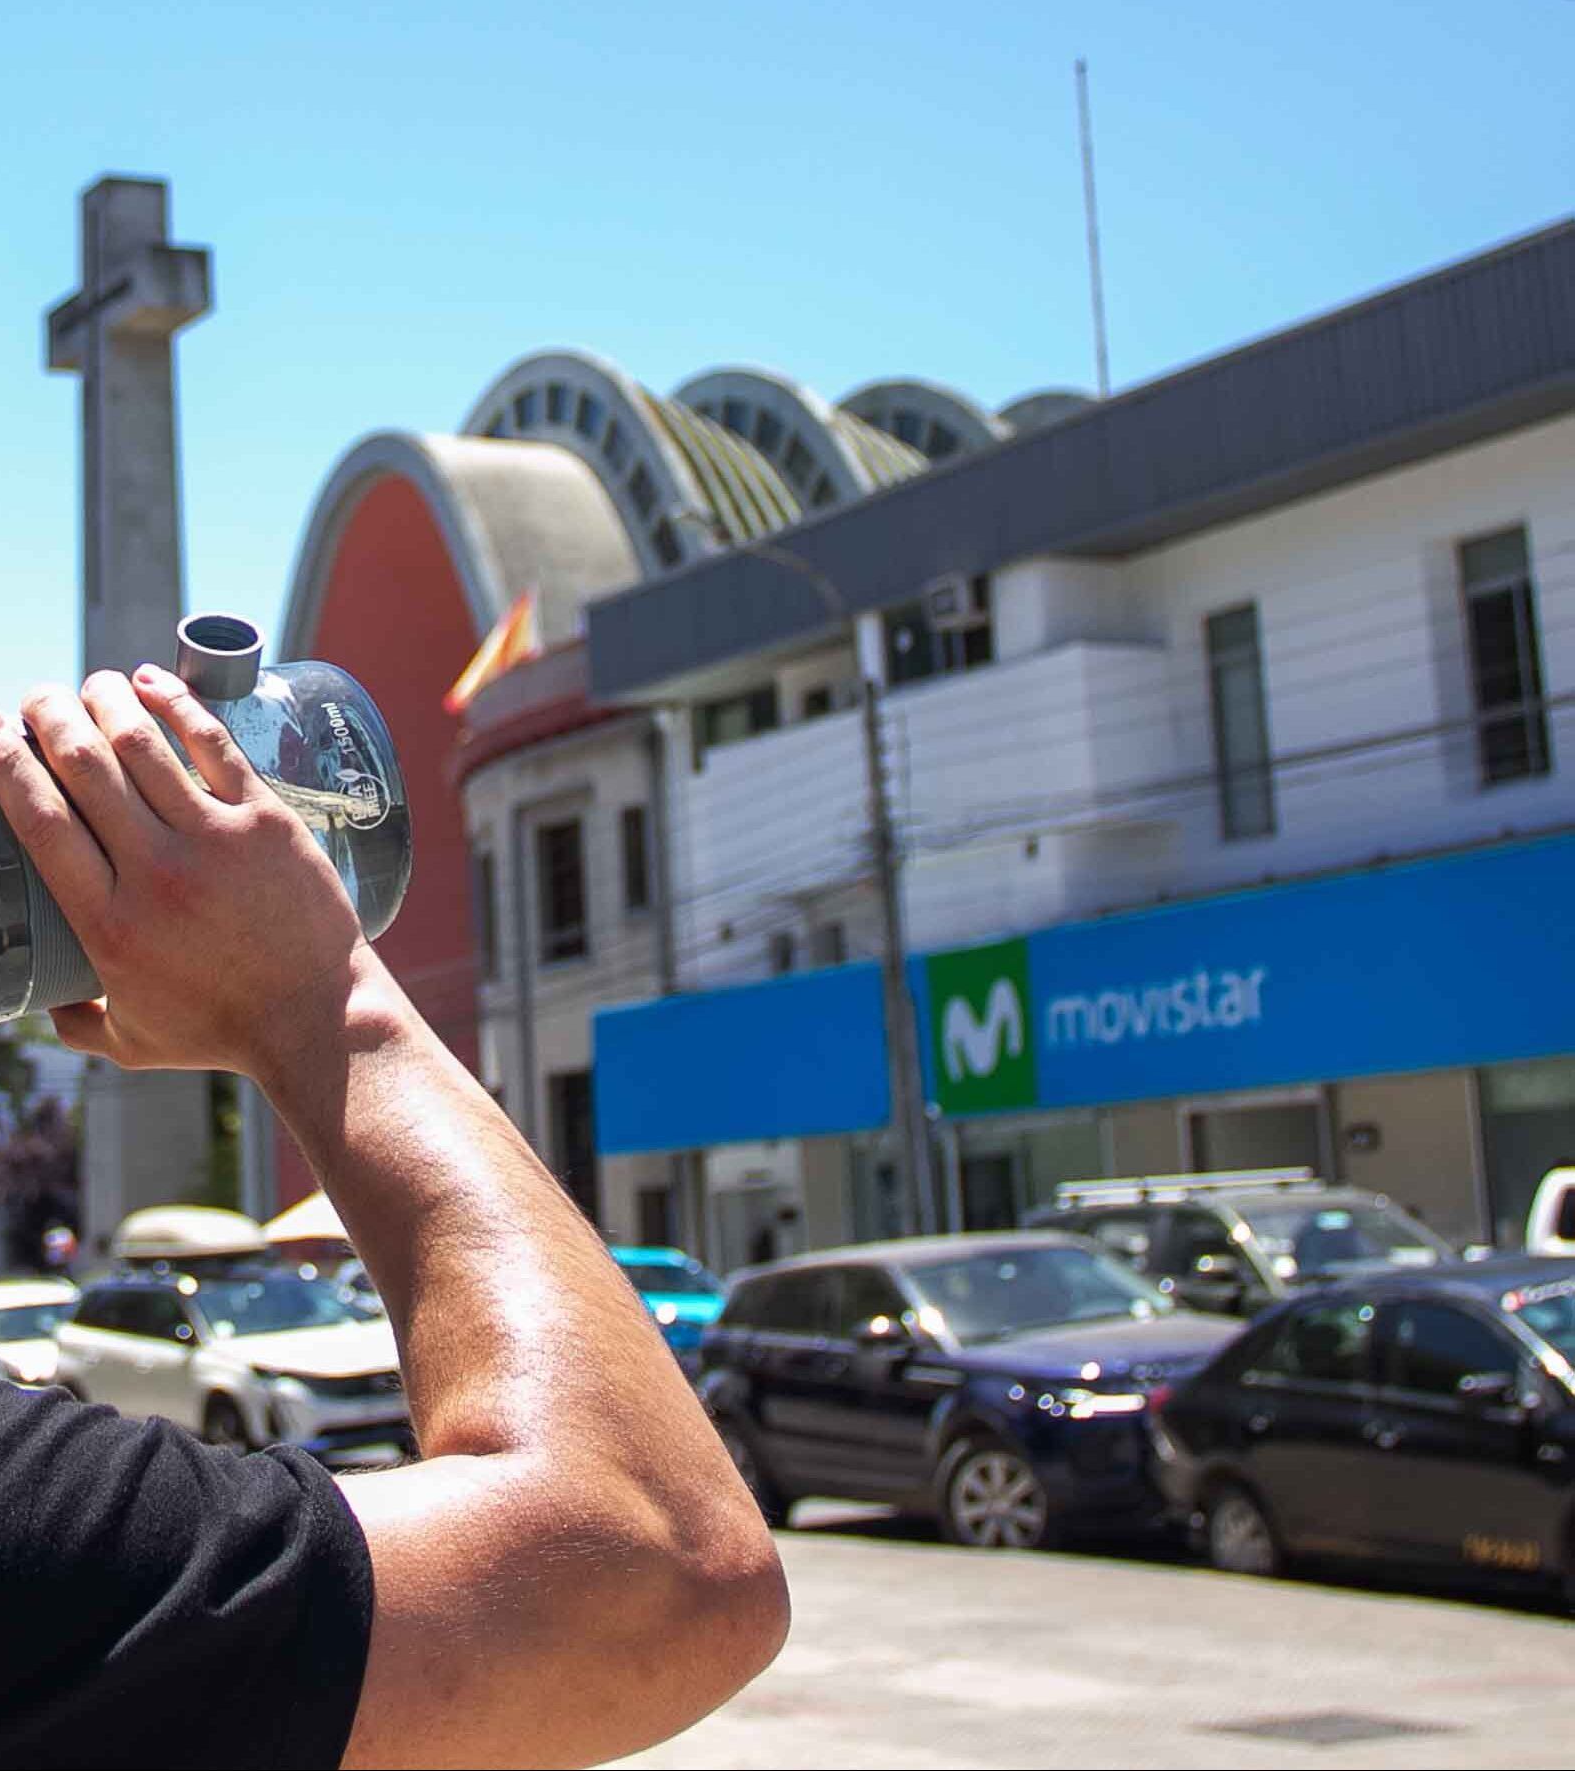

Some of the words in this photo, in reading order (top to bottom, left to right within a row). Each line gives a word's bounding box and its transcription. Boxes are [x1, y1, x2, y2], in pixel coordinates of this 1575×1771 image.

[321, 702, 355, 755] 1500ml
[363, 780, 382, 818] FREE
[1048, 966, 1266, 1044] movistar
